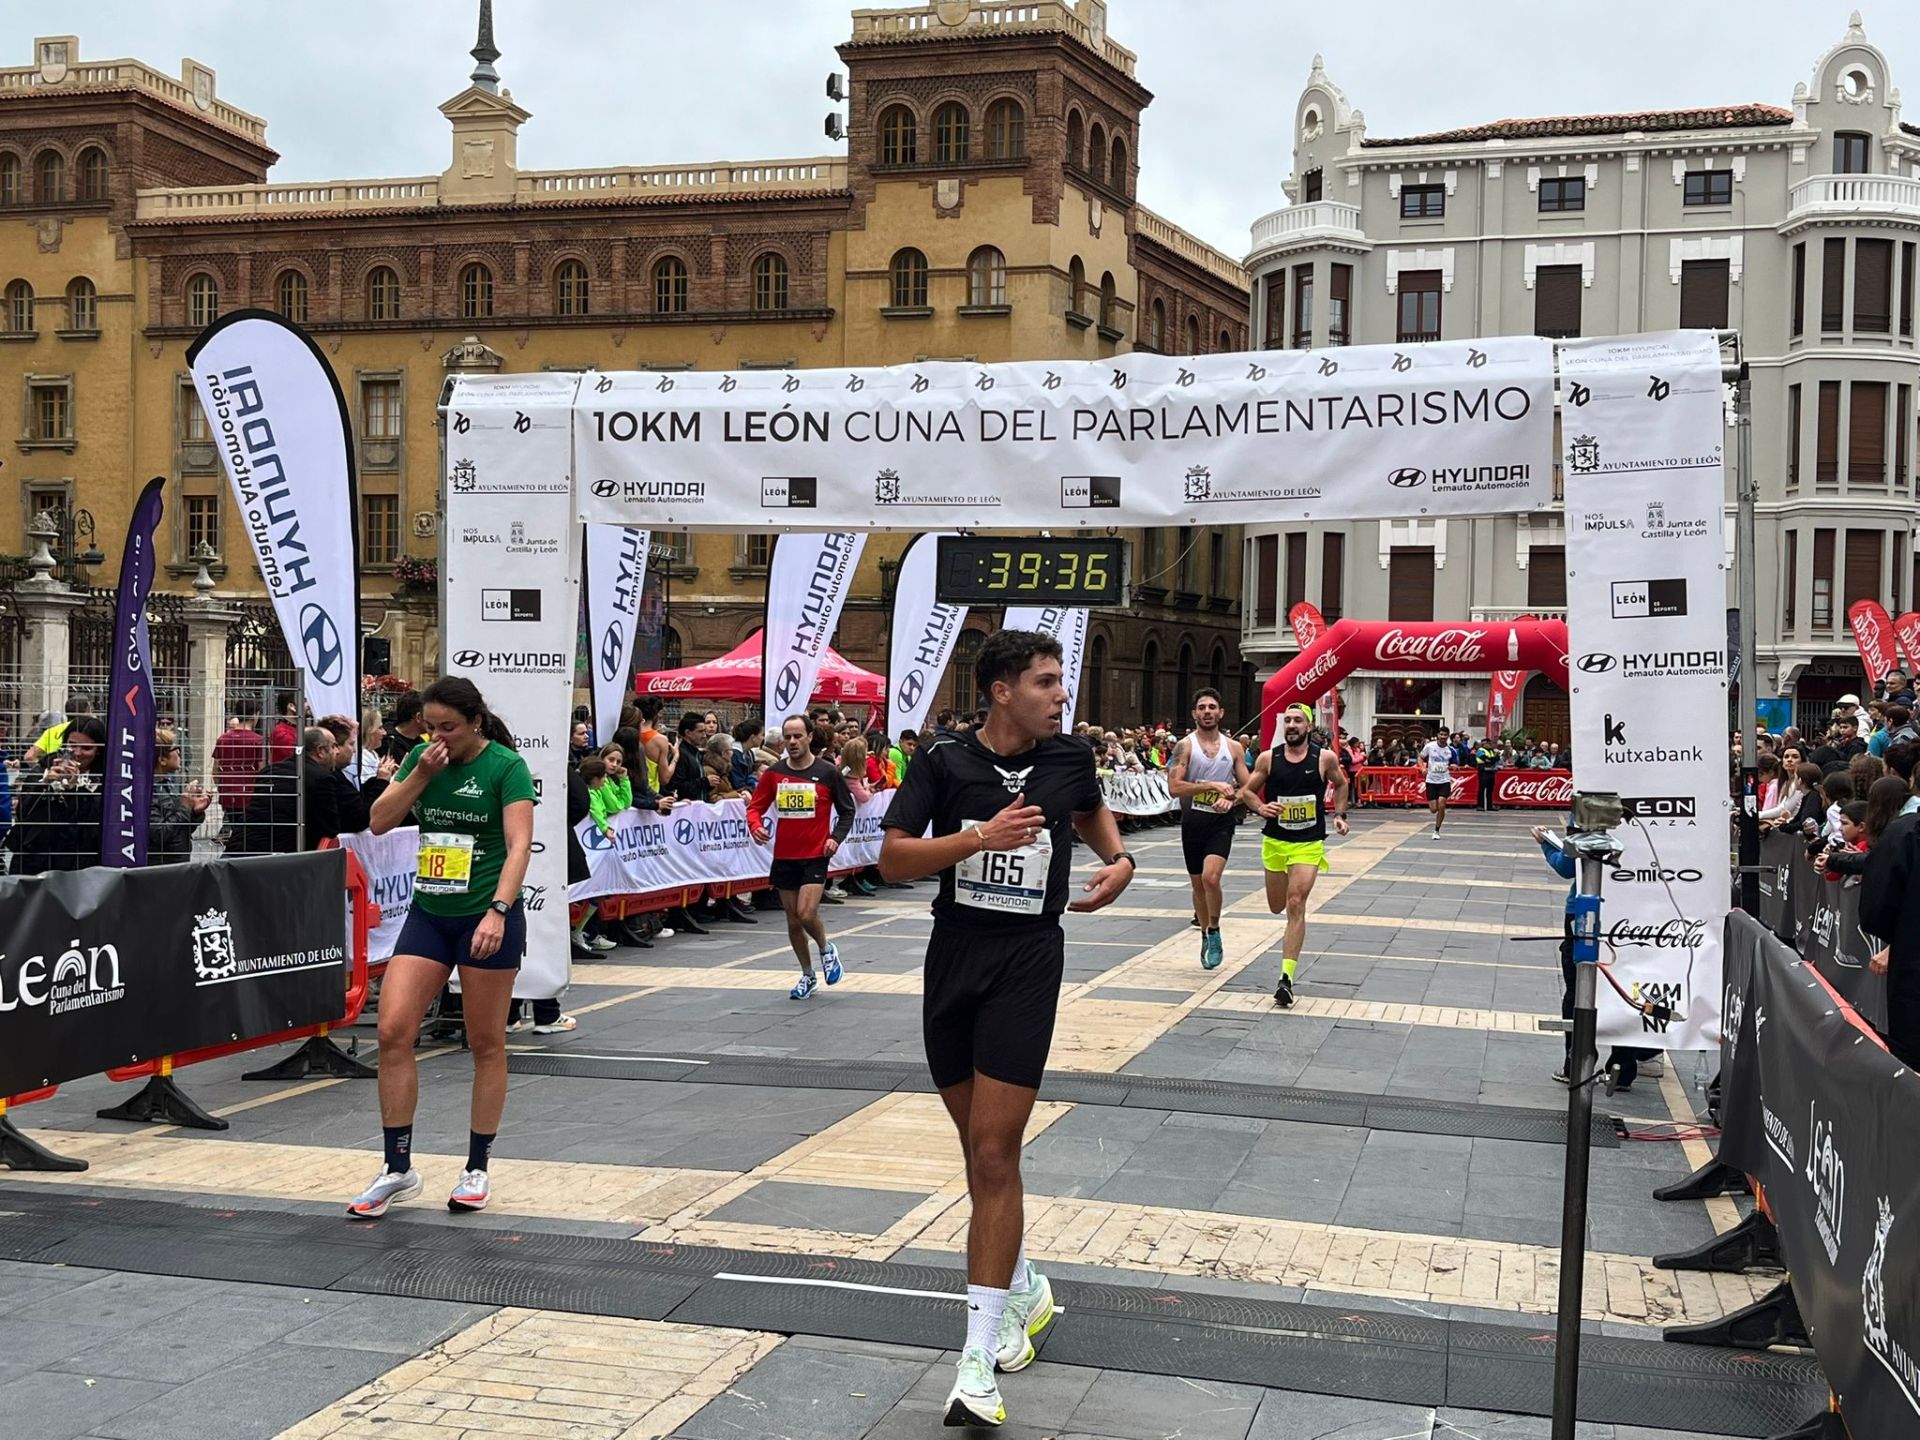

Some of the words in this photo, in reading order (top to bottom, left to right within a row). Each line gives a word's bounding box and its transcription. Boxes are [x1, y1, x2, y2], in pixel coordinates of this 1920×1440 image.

[593, 411, 700, 442] 10KM
[724, 403, 829, 442] LEÓN
[845, 410, 965, 442] CUNA
[980, 410, 1057, 442] DEL
[1073, 387, 1531, 441] PARLAMENTARISMO
[1602, 458, 1678, 471] AYUNTAMIENTO
[1680, 458, 1694, 466] DE
[1696, 454, 1720, 465] LEÓN
[1432, 464, 1529, 484] HYUNDAI
[477, 483, 536, 491] AYUNTAMIENTO
[538, 483, 547, 491] DE
[549, 482, 568, 491] LEÓN
[624, 481, 705, 496] HYUNDAI
[764, 485, 787, 496] LEÓN
[1065, 485, 1088, 496] LEÓN
[1213, 490, 1281, 499] AYUNTAMIENTO
[1283, 488, 1295, 496] DE
[1297, 487, 1321, 495] LEÓN
[1432, 484, 1472, 492] Lemauto
[1475, 480, 1529, 491] Automoción
[624, 496, 656, 504] Lemauto
[657, 496, 704, 504] Automoción
[980, 494, 1001, 503] LEÓN
[1585, 519, 1634, 531] IMPULSA
[1667, 521, 1693, 529] Junta
[463, 535, 501, 544] IMPULSA
[1641, 530, 1675, 539] Castilla
[1684, 528, 1707, 537] León
[791, 531, 846, 655] HYUNDA
[1617, 592, 1646, 604] LEÓN
[485, 598, 508, 609] LEÓN
[808, 605, 832, 658] Lemauto
[1375, 629, 1488, 661] Coca-Cola
[489, 652, 566, 667] HYUNDAI
[1623, 651, 1723, 670] HYUNDAI
[489, 666, 522, 674] Lemauto
[523, 666, 566, 674] Automoción
[1623, 669, 1664, 678] Lemauto
[1666, 667, 1724, 677] Automoción
[1605, 745, 1703, 763] kutxabank
[120, 727, 137, 863] ALTAFIT
[786, 795, 804, 808] 138
[424, 807, 488, 823] universidad
[1289, 807, 1307, 821] 109
[1636, 800, 1694, 815] EON
[429, 854, 446, 878] 18
[982, 851, 1025, 887] 165
[1611, 861, 1703, 882] emico
[988, 894, 1031, 907] HYUNDAI
[1608, 919, 1706, 948] Coca-Cola
[308, 950, 319, 961] DE
[321, 945, 342, 960] LEÓN
[50, 985, 72, 999] Cuna
[73, 978, 86, 994] del
[50, 988, 125, 1016] Parlamentarismo
[1805, 1099, 1845, 1247] León
